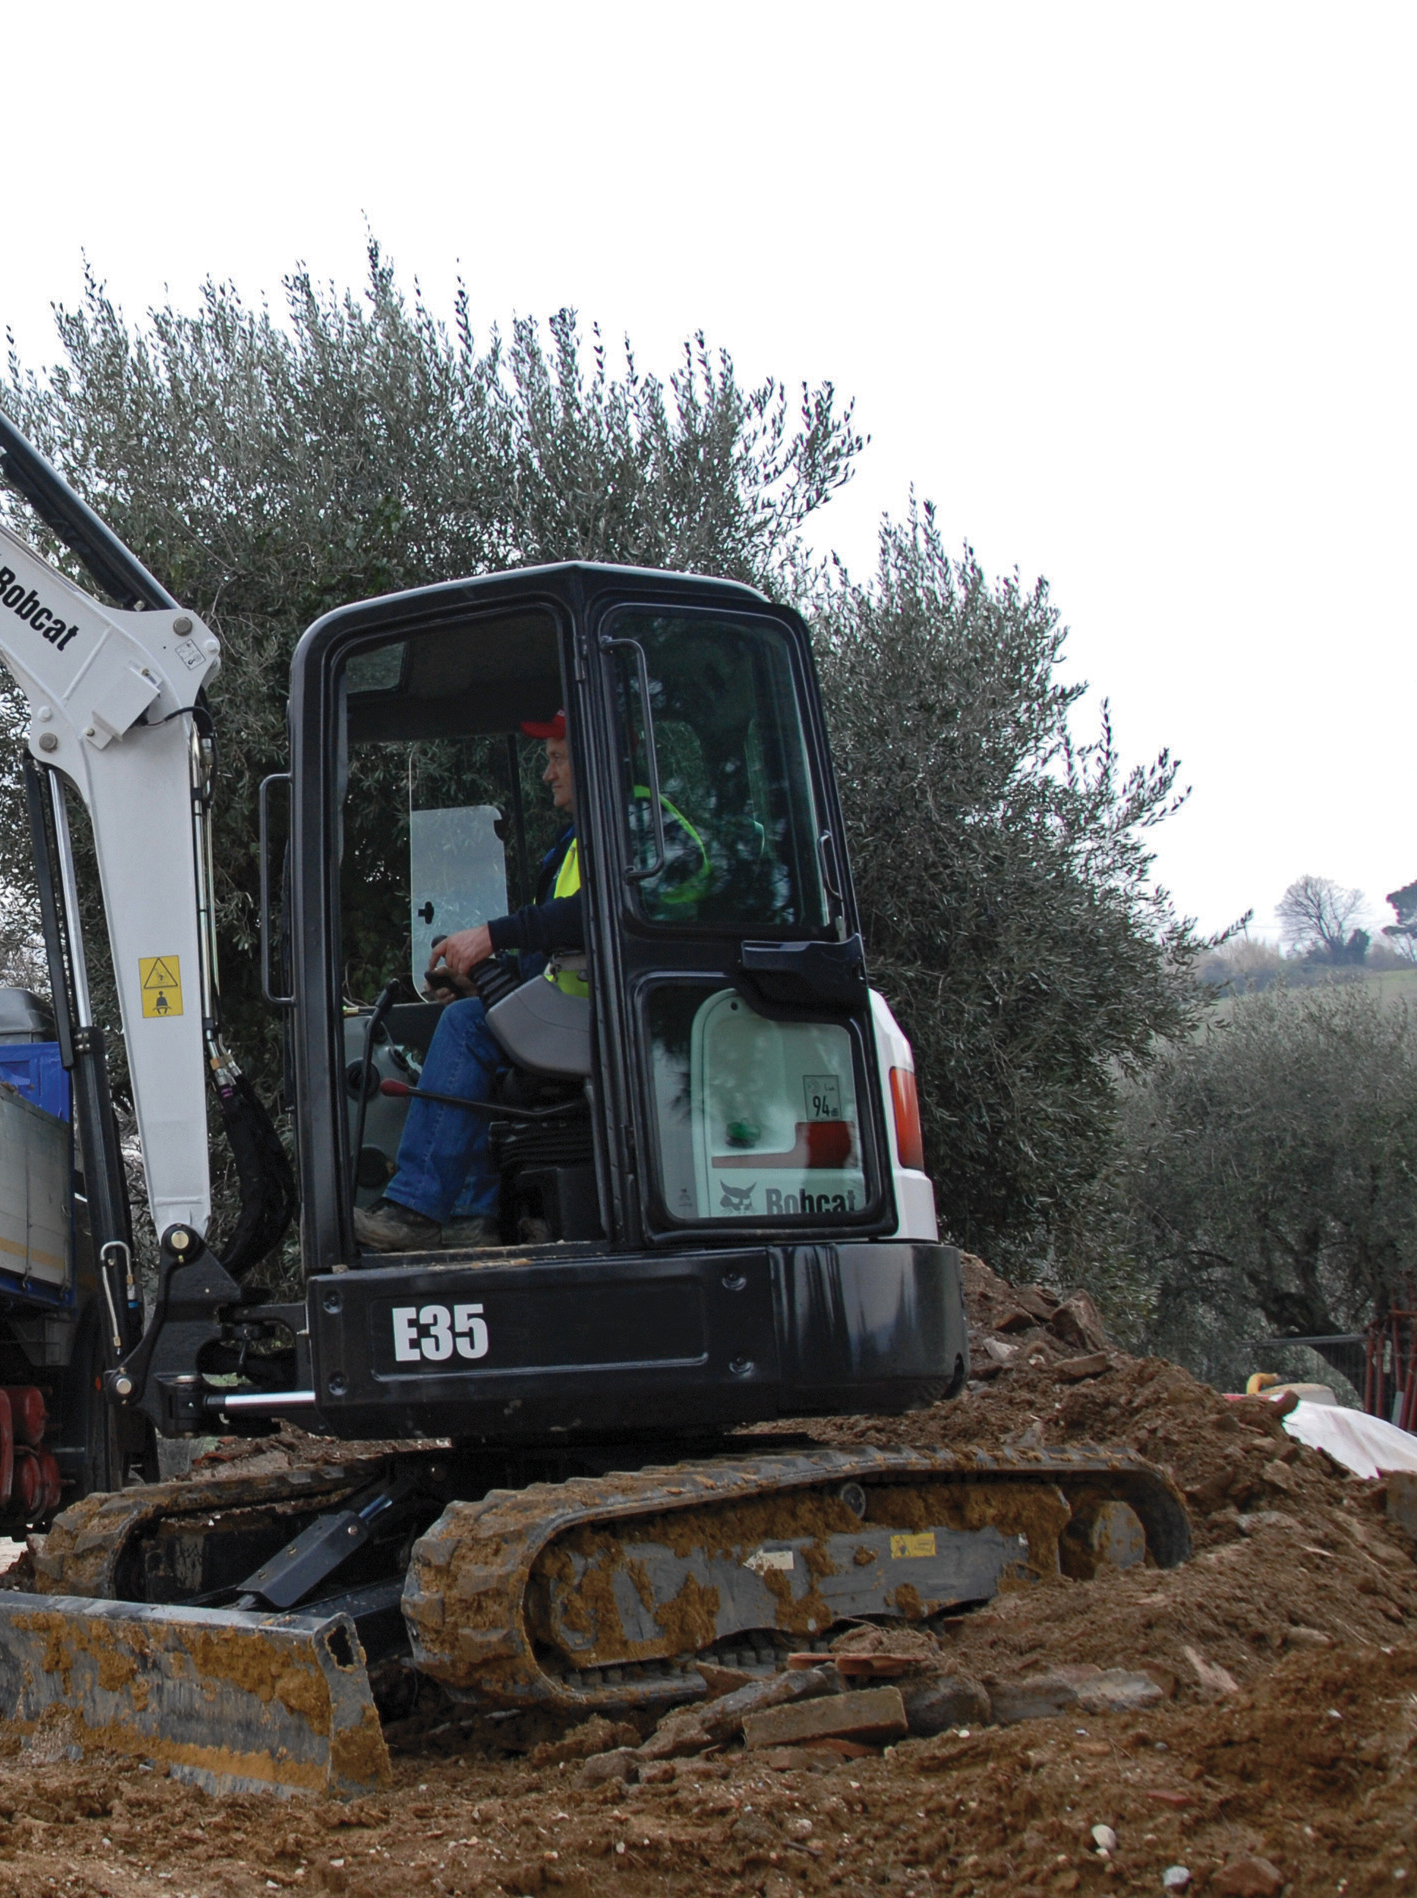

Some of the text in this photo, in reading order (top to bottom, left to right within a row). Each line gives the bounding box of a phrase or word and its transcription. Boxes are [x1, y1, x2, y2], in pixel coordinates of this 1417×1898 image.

[813, 1095, 830, 1117] 94
[766, 1188, 856, 1215] Bobcat
[392, 1303, 489, 1362] E35
